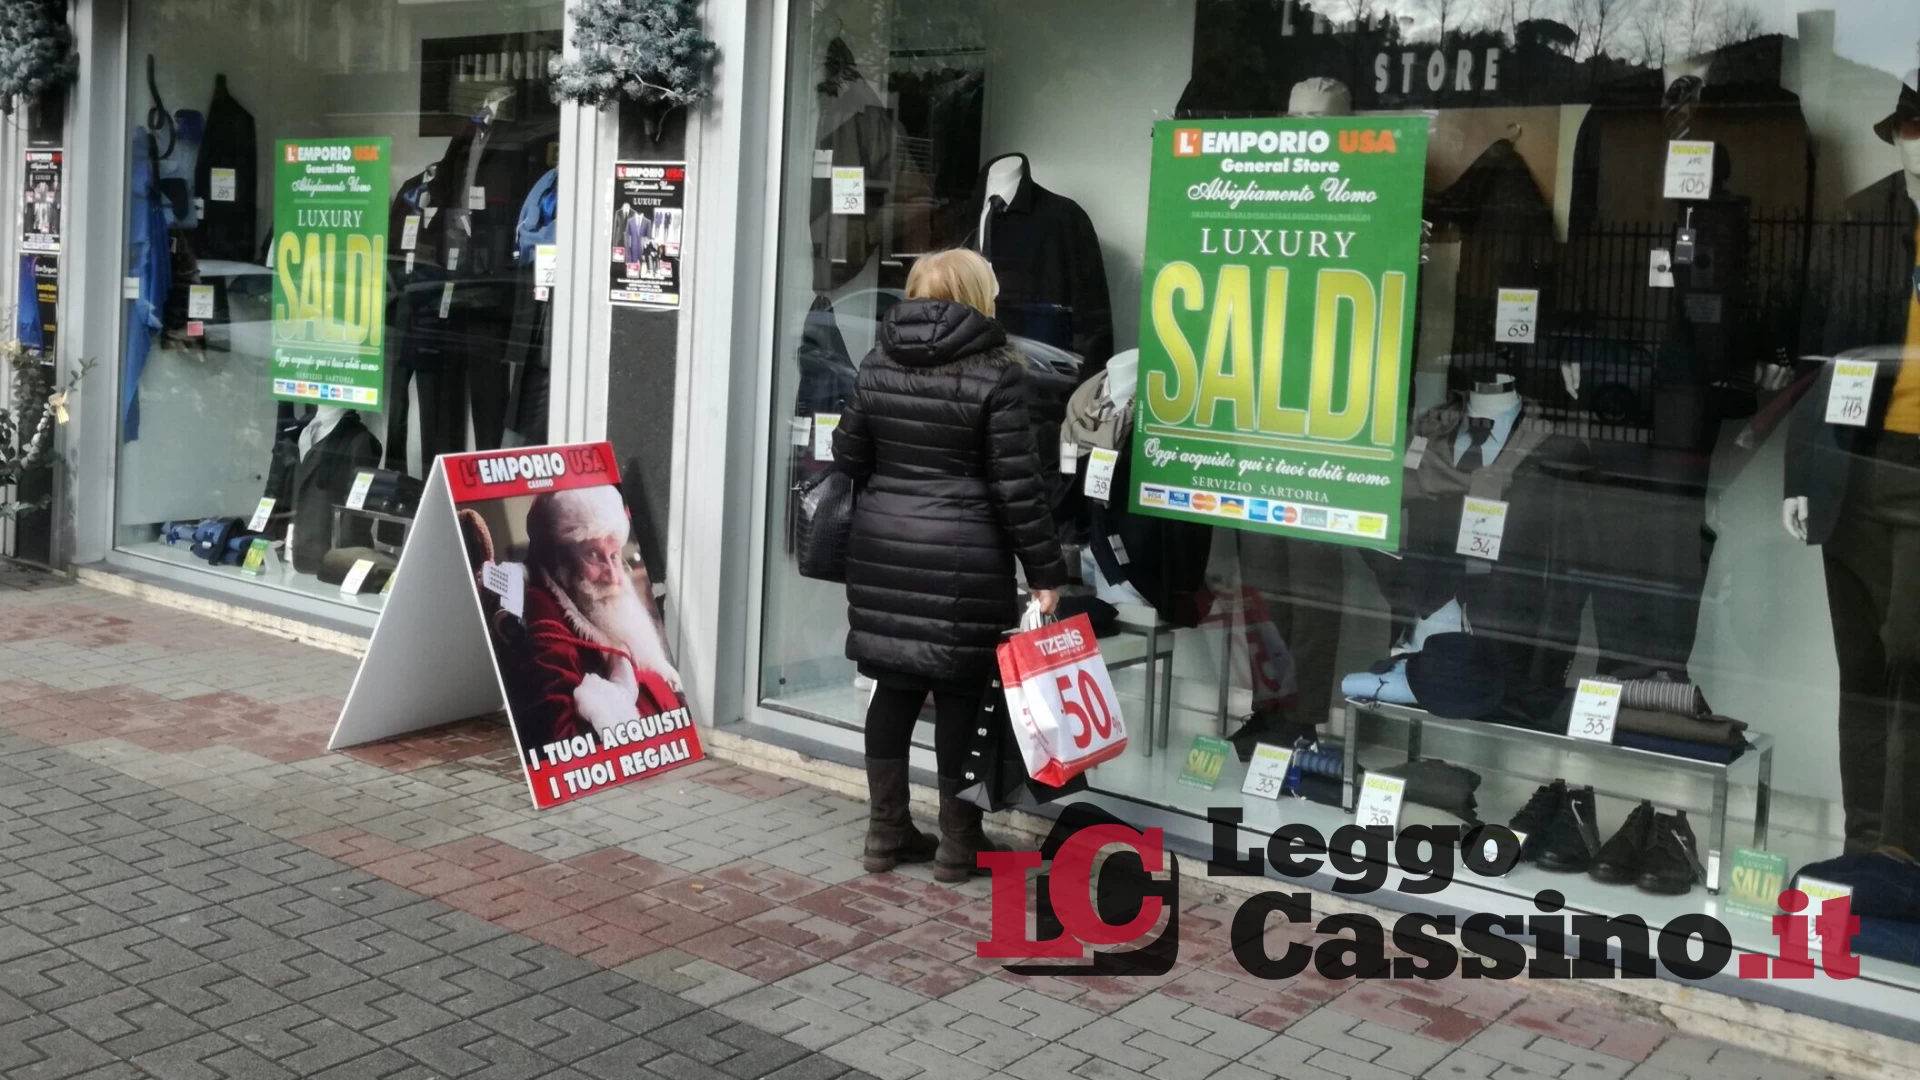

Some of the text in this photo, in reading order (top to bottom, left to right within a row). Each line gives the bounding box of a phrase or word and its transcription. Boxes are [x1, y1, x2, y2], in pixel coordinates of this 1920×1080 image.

[1374, 48, 1500, 93] STORE
[287, 146, 352, 161] L'EMPORIO
[1179, 130, 1396, 154] L'EMPORIO USA
[1221, 158, 1340, 173] General Store
[1187, 177, 1378, 210] Abbigliamento Uomo
[297, 209, 363, 228] LUXURY
[1200, 228, 1357, 258] LUXURY
[275, 231, 384, 346] SALDI
[1507, 323, 1529, 337] 69
[1147, 260, 1406, 445] SALDI
[460, 446, 608, 487] L'EMPORIO USA
[1144, 437, 1391, 487] Oggi acquista qui i tuoi abiti uomo
[1191, 474, 1329, 503] SERVIZIO SARTORIA
[528, 706, 691, 771] I TUOI ACQUISTI
[1582, 717, 1605, 735] 33
[549, 738, 691, 799] I TUOI REGALI
